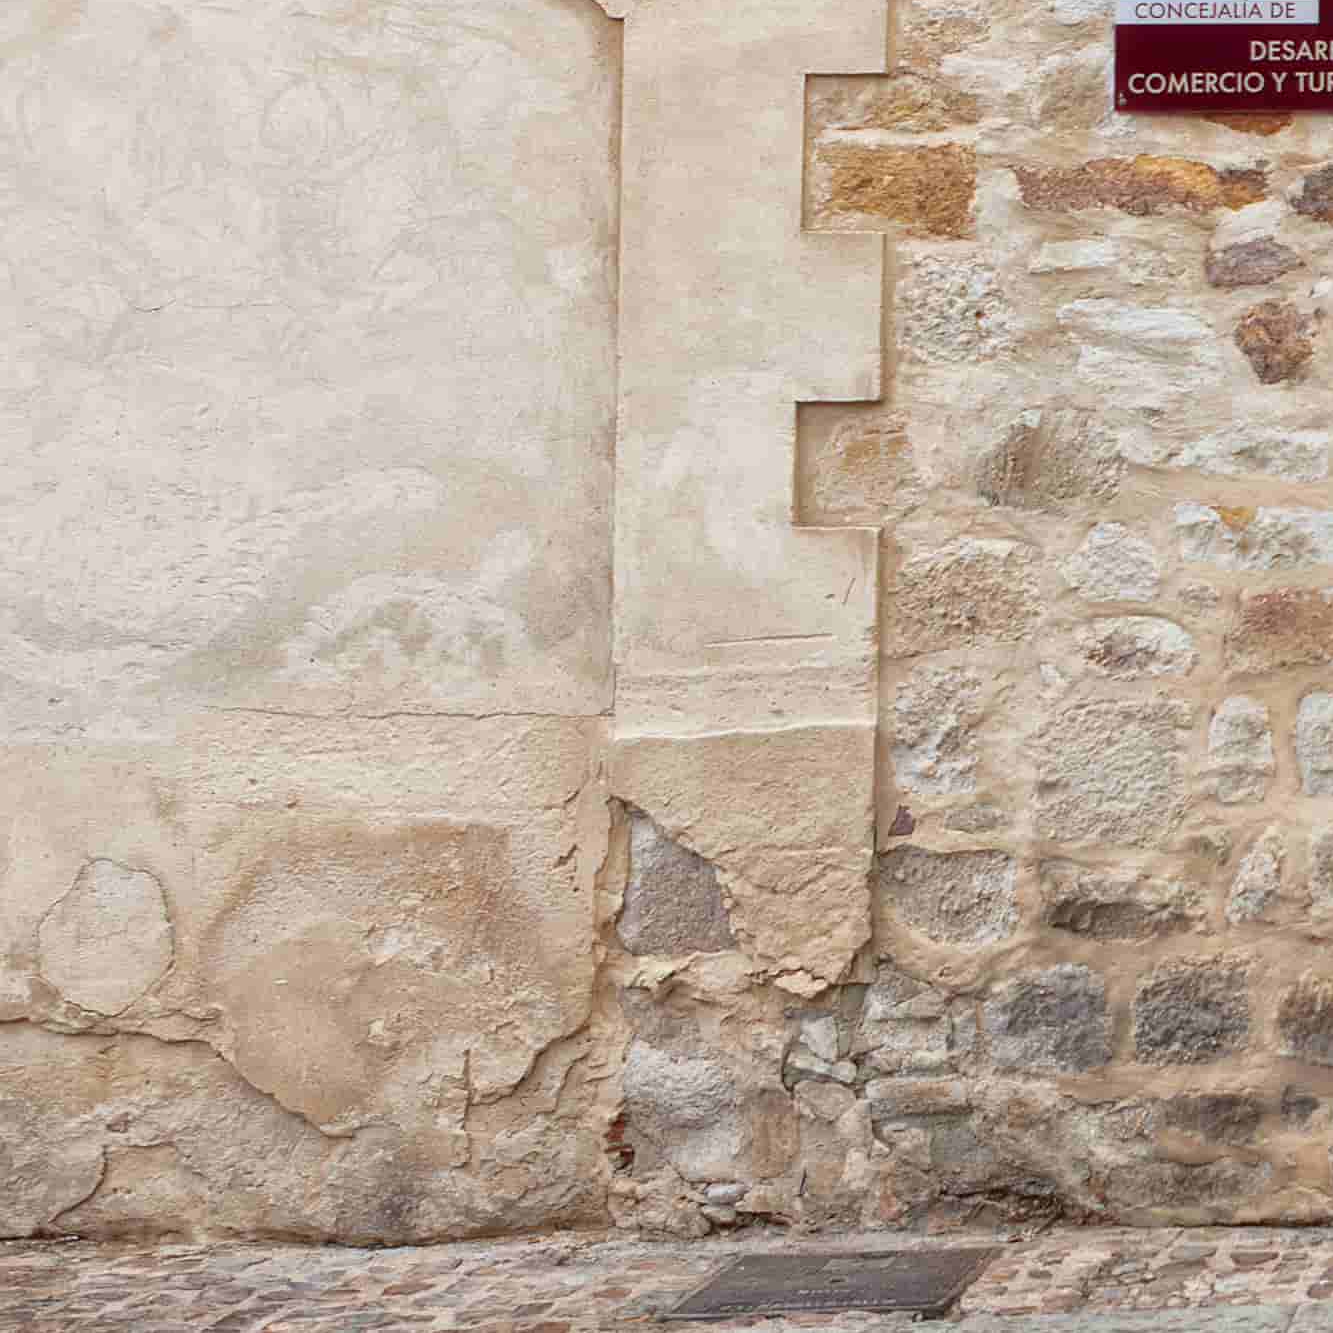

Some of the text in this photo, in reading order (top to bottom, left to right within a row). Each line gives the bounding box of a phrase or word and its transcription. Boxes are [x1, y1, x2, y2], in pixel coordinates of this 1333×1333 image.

[1270, 2, 1296, 19] DE
[1127, 71, 1265, 94] COMERCIO
[1272, 72, 1288, 92] Y
